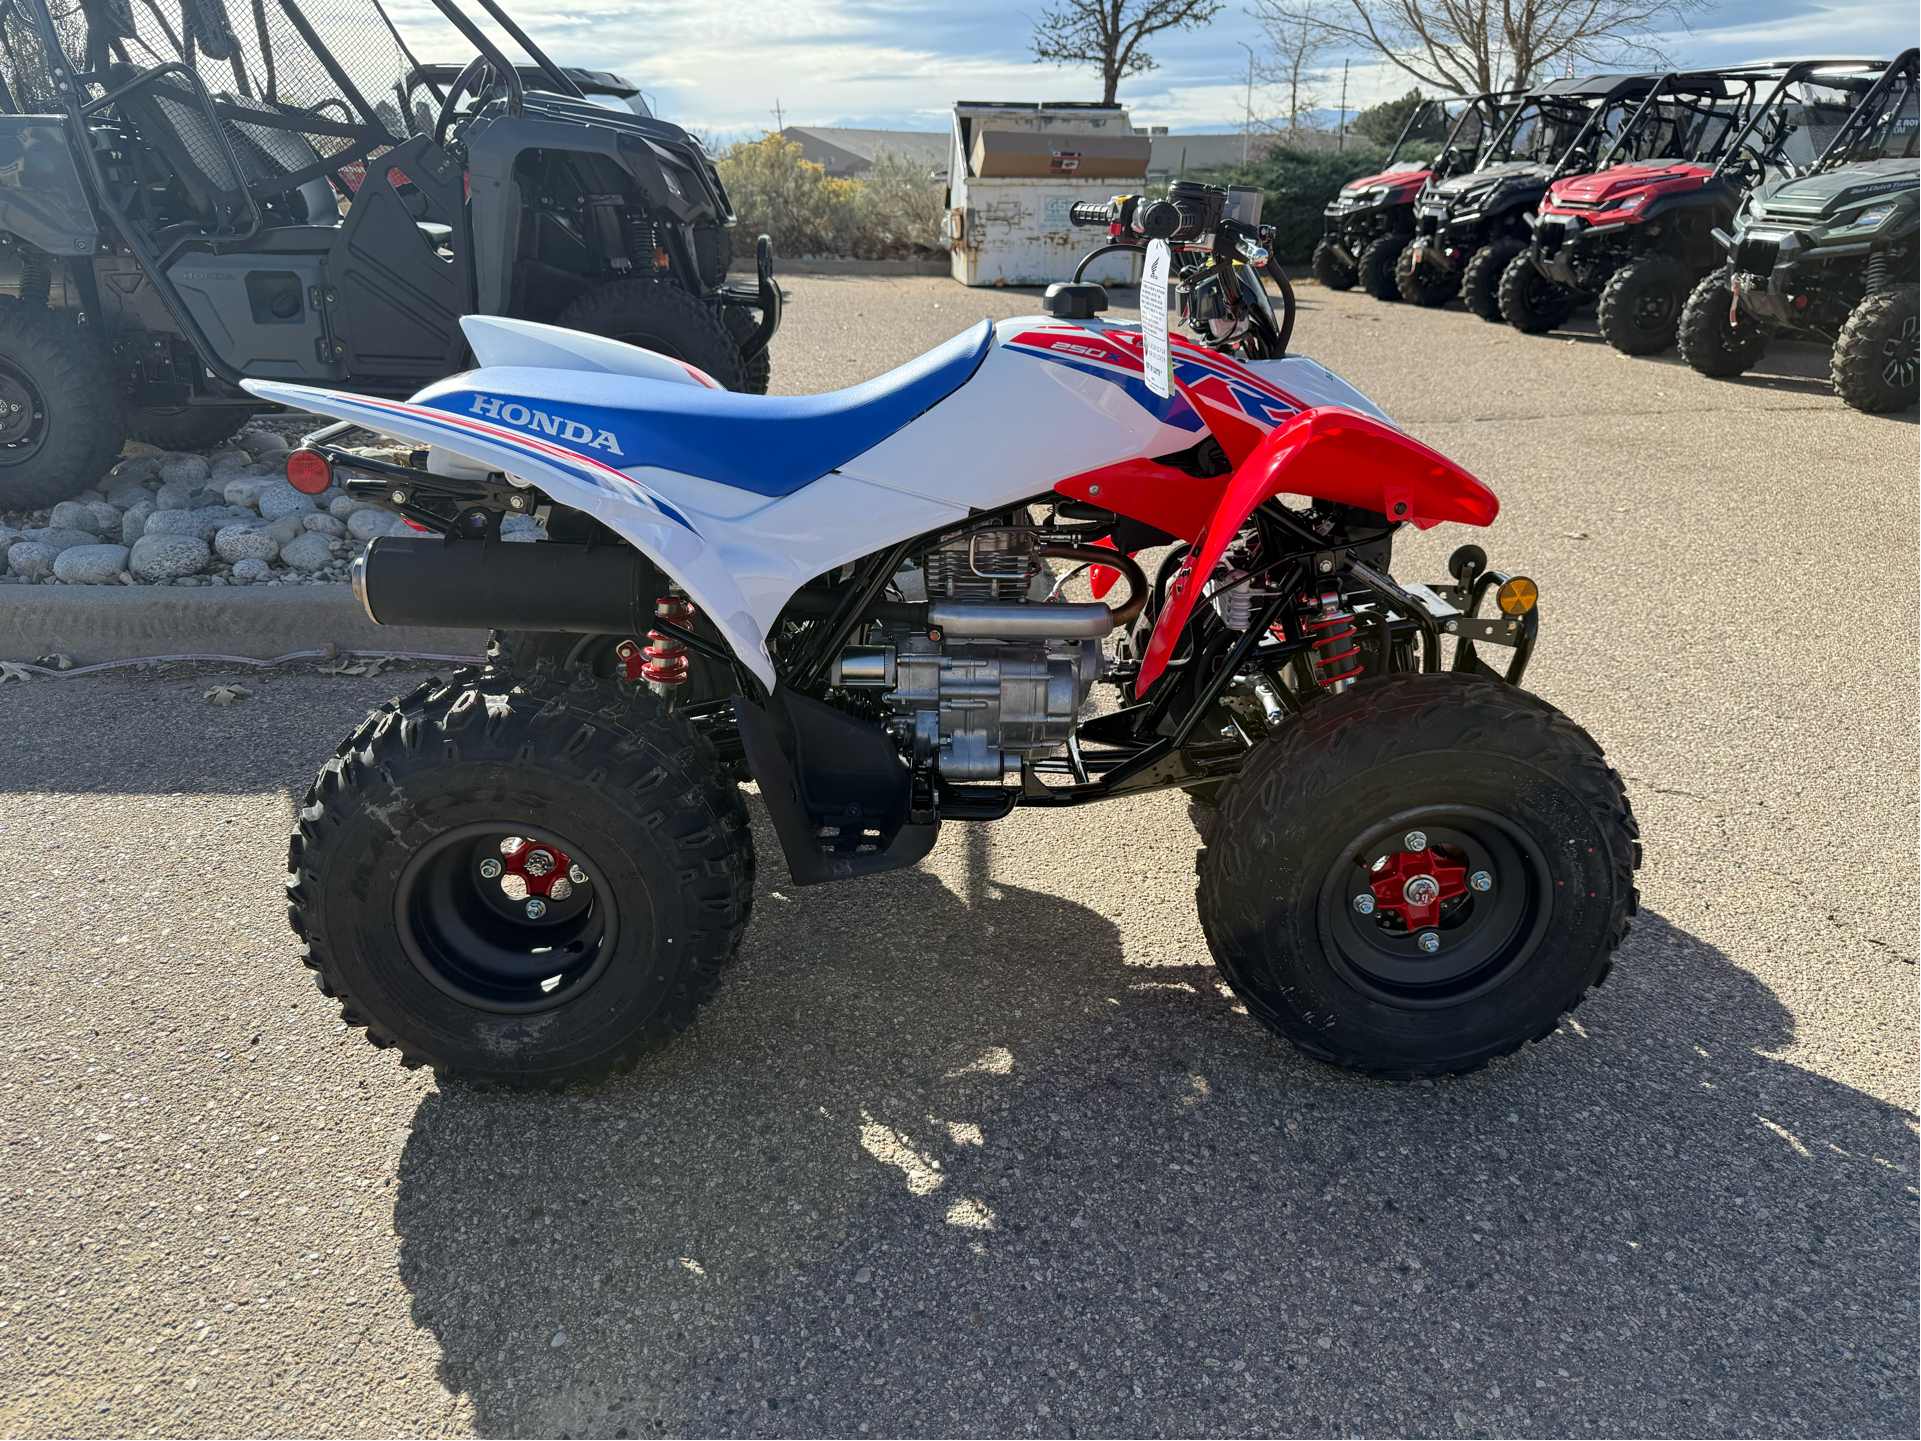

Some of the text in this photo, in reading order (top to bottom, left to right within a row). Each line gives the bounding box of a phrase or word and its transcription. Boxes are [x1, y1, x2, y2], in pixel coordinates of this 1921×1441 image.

[1850, 186, 1869, 194] Dual
[1050, 341, 1125, 363] 250X
[468, 394, 625, 457] HONDA
